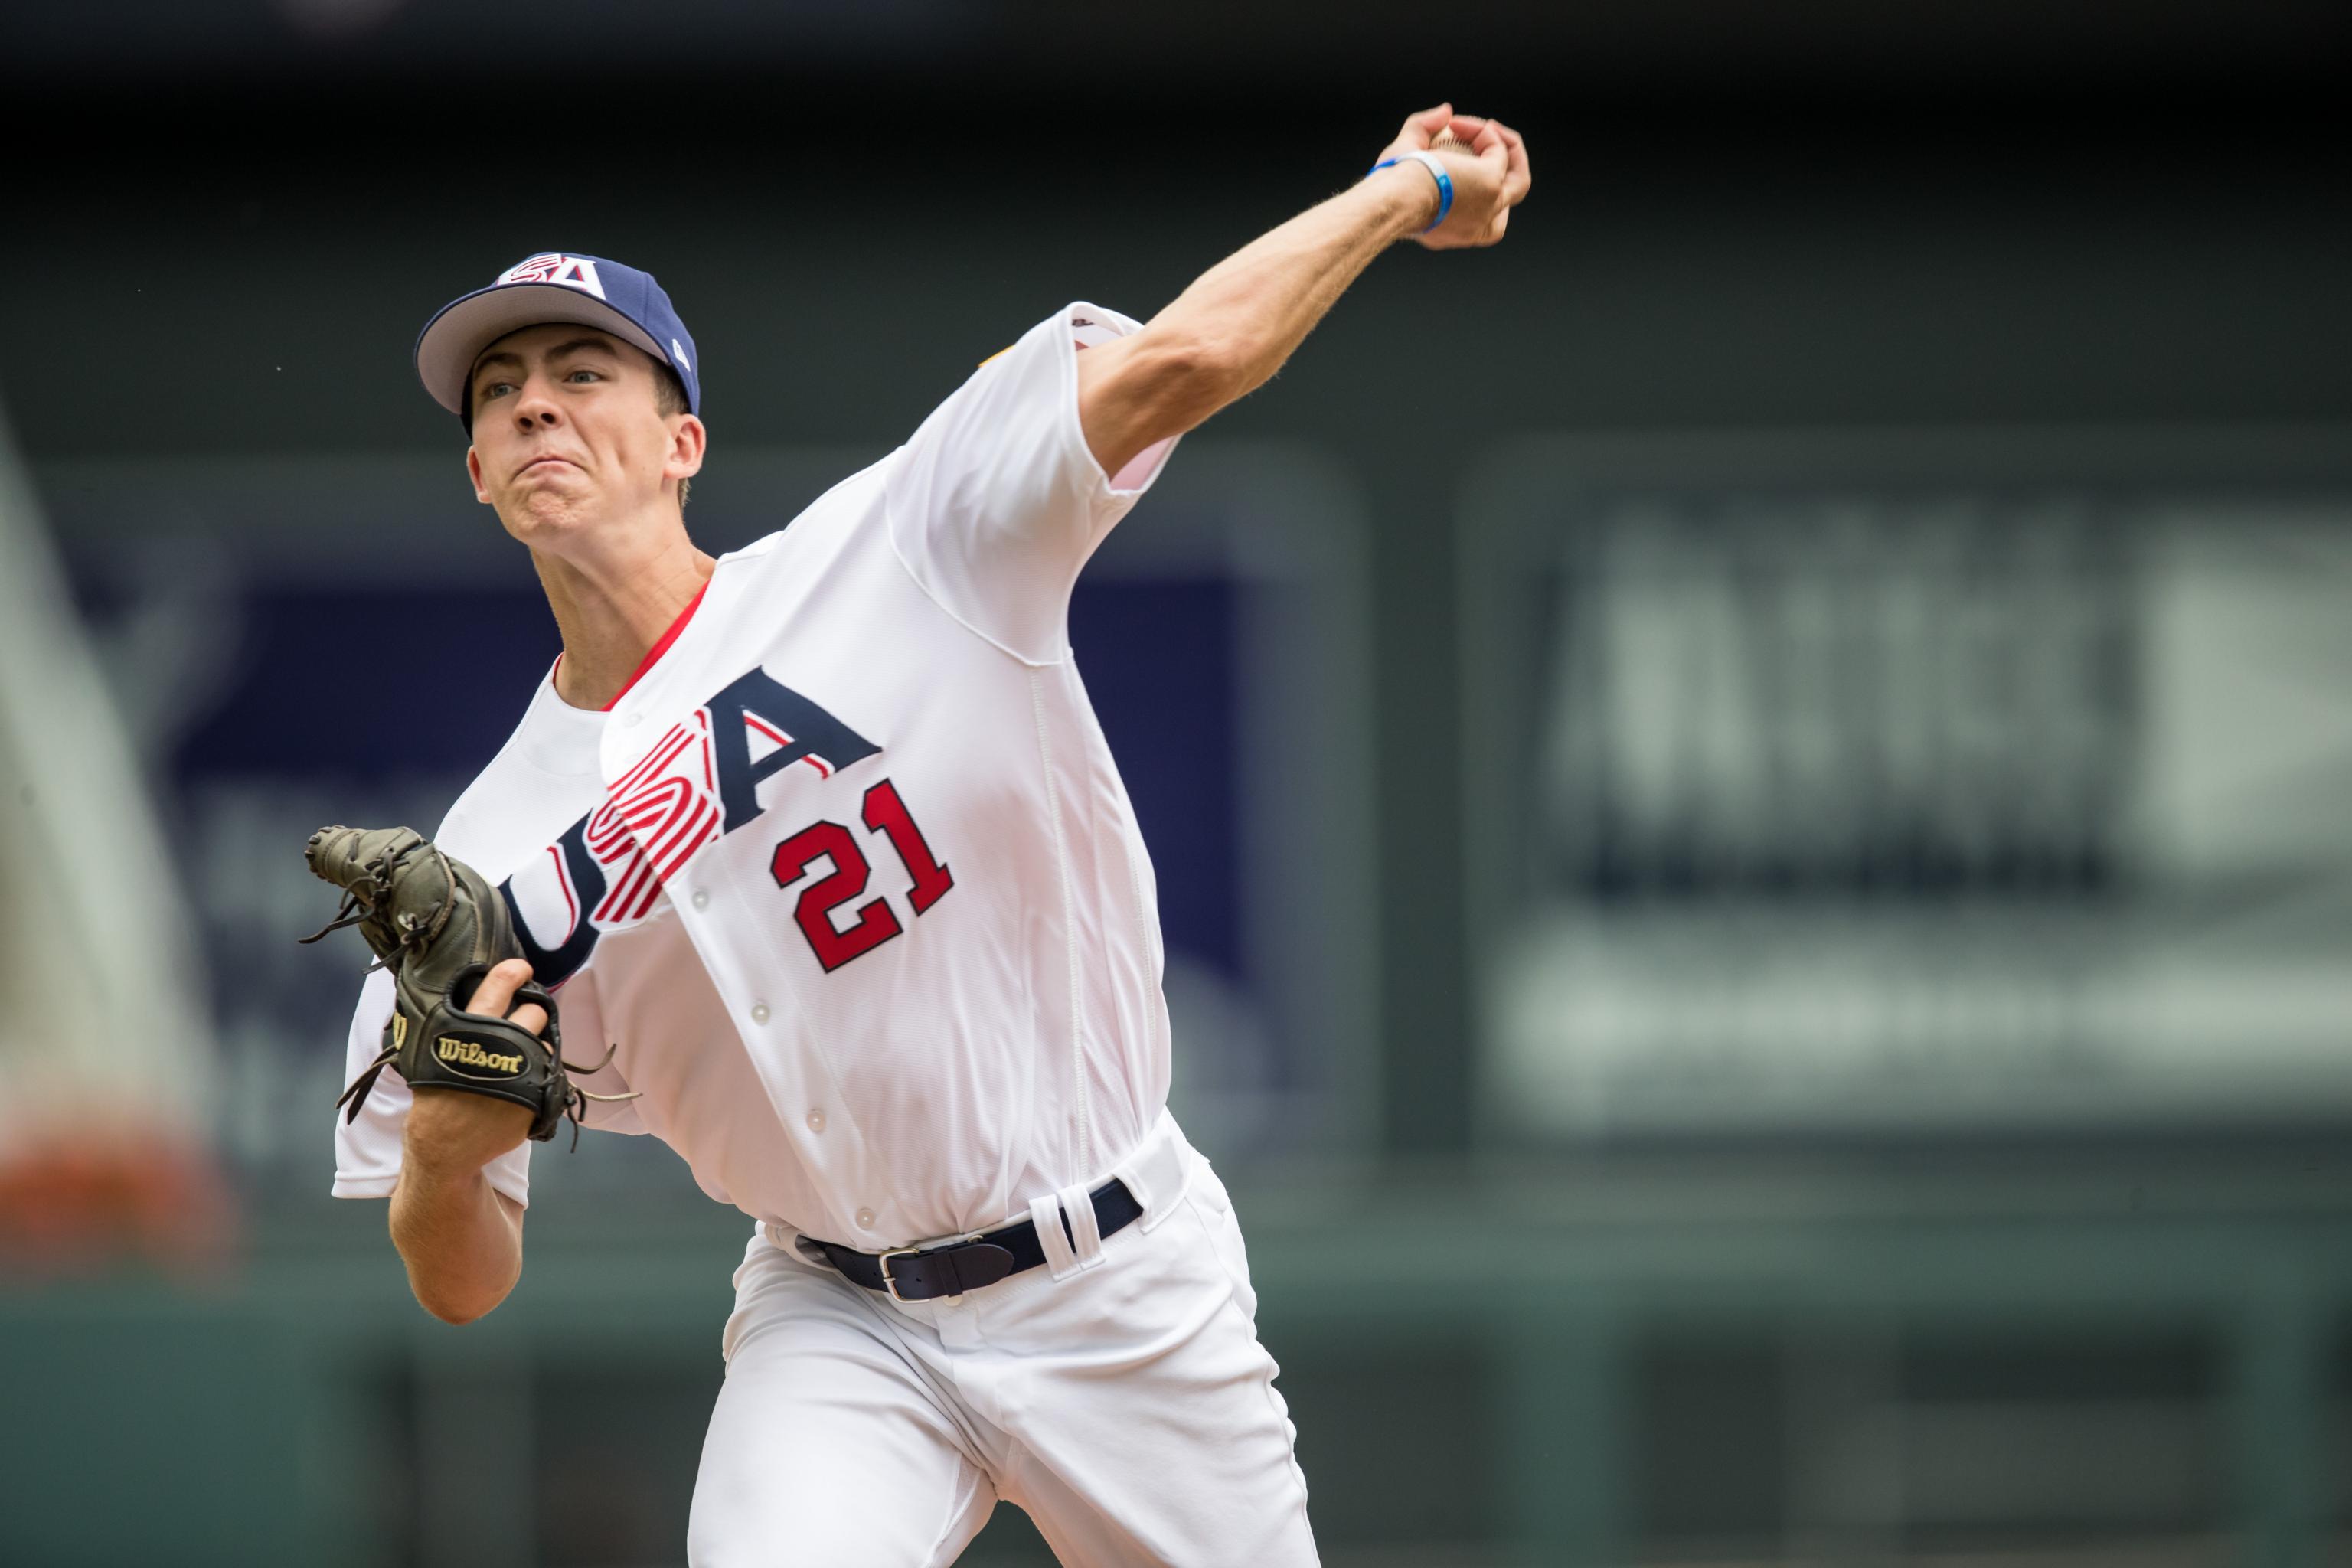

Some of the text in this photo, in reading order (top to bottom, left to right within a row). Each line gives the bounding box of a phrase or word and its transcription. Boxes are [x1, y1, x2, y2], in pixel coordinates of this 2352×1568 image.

[497, 253, 606, 300] SA
[498, 665, 883, 994] USA
[770, 777, 954, 973] 21
[439, 1037, 523, 1073] Wilson
